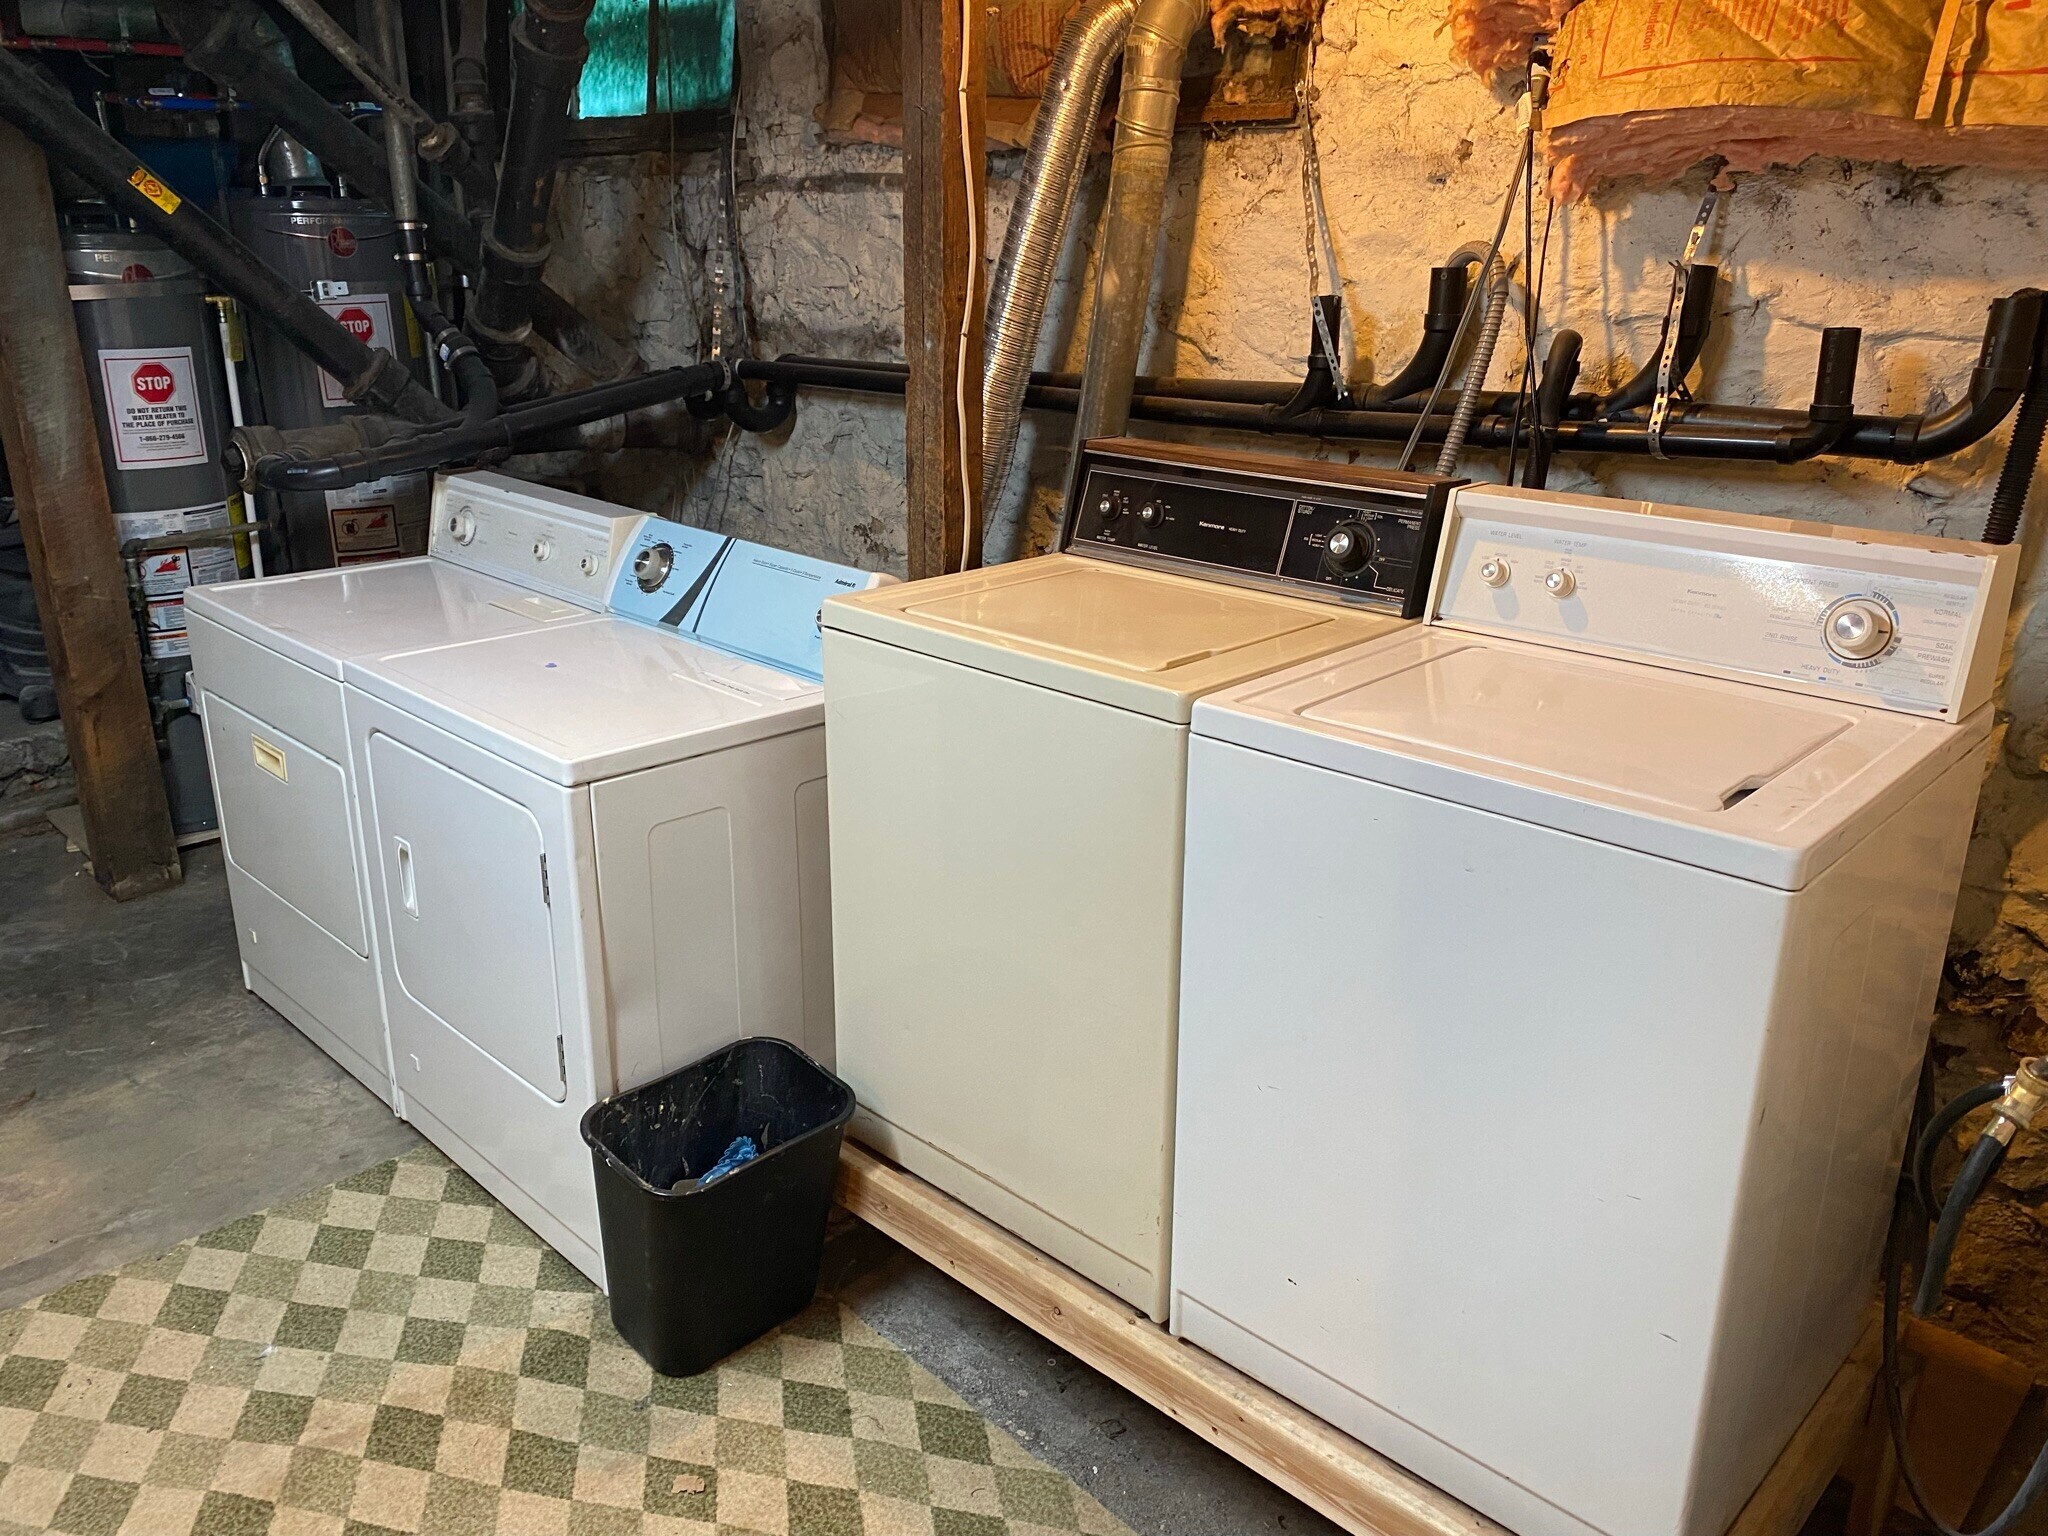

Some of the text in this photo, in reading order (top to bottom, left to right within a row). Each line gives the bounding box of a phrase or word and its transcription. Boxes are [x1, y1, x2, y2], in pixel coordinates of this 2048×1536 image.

[136, 376, 171, 391] STOP
[126, 407, 136, 415] DO
[1199, 521, 1225, 530] Kenmore
[834, 579, 852, 588] Admiral
[1819, 580, 1839, 588] PRESS
[1687, 589, 1718, 597] Kenmore
[1934, 609, 1961, 618] NORMAL
[1780, 634, 1798, 642] RINSE
[1936, 642, 1953, 650] SOAK
[1916, 653, 1950, 663] PREWASH
[1800, 663, 1840, 675] HEAVY DUTY
[1919, 678, 1944, 686] REGULAR
